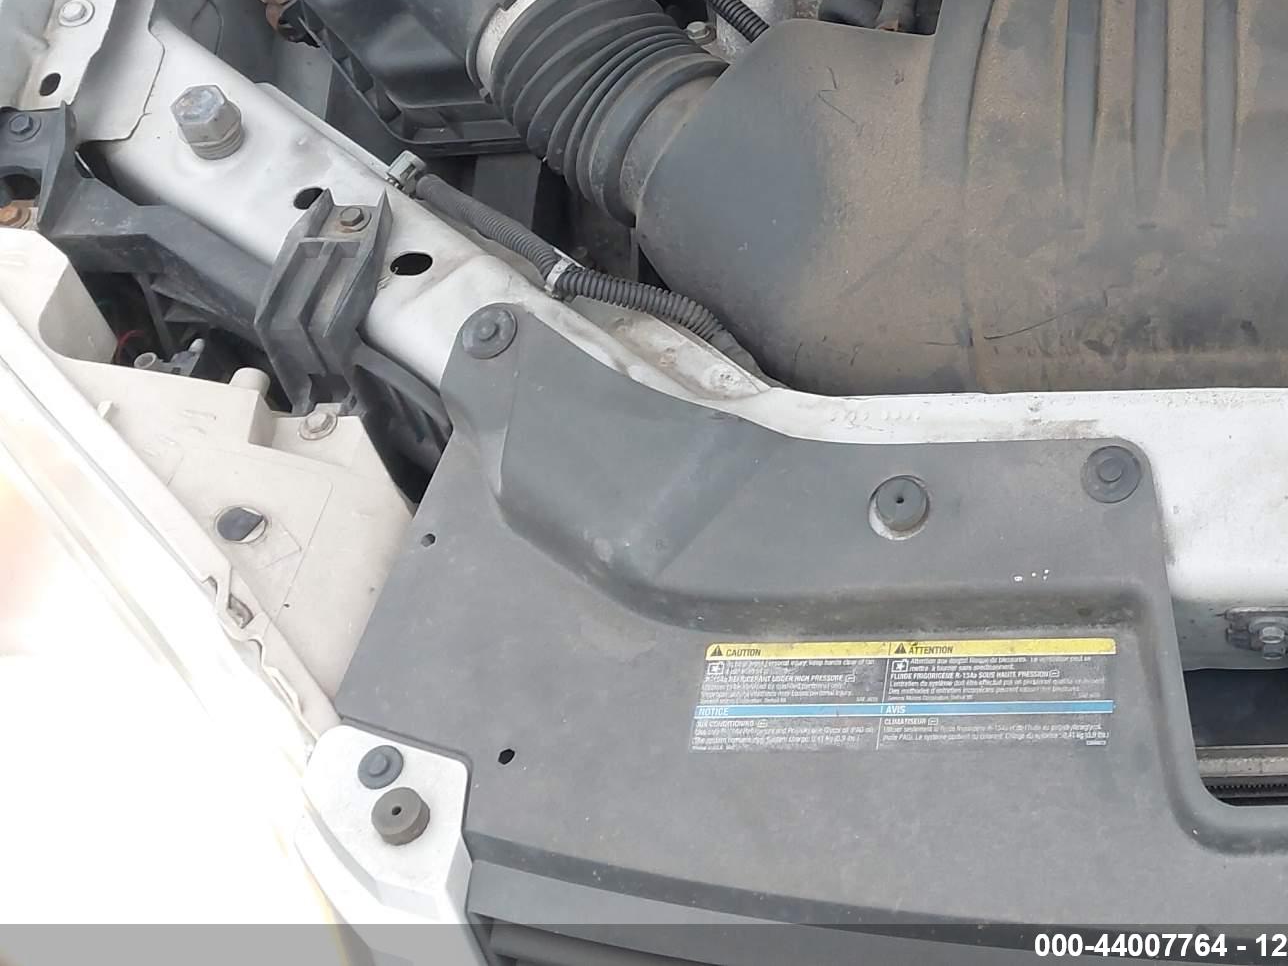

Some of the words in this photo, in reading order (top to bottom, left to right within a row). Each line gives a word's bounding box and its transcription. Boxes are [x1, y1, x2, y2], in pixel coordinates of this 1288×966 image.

[726, 648, 761, 656] CAUTION
[908, 645, 953, 654] ATTENTION
[698, 708, 729, 716] NOTICE
[885, 705, 906, 714] AVIS
